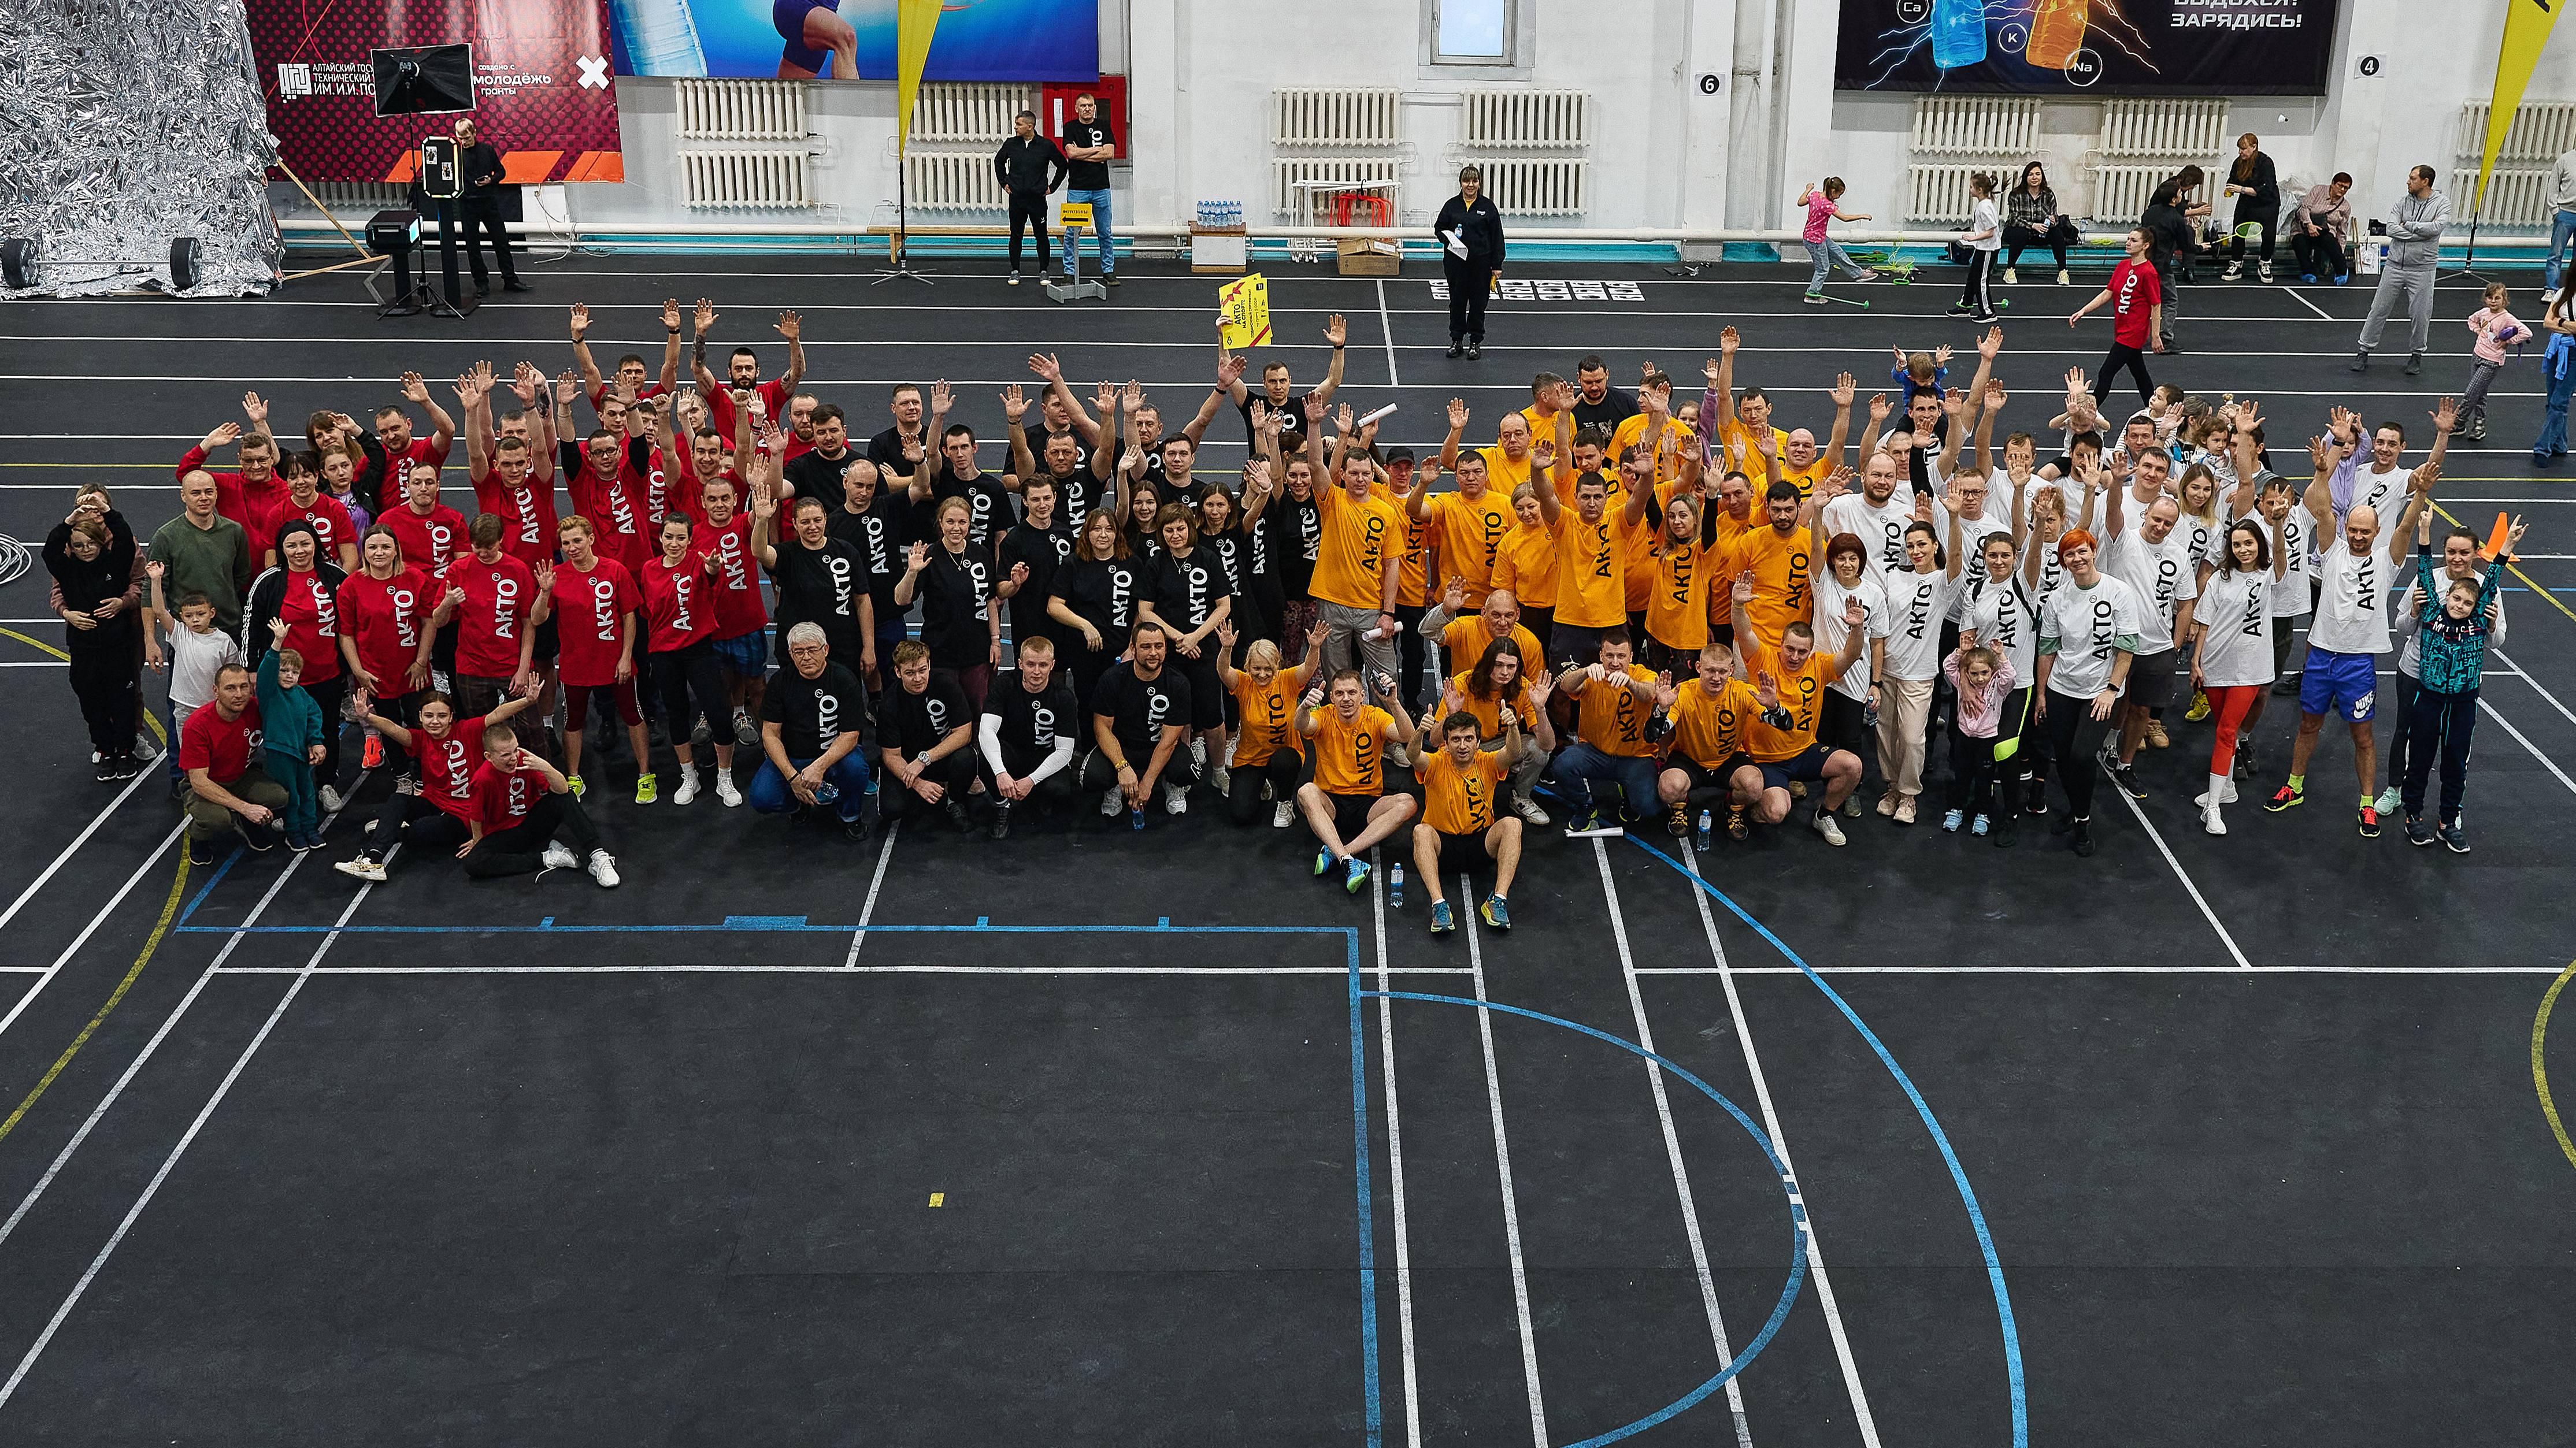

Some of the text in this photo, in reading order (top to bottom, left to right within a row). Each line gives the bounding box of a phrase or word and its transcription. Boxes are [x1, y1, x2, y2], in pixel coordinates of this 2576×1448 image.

[1903, 2, 1921, 12] Ca
[2170, 13, 2302, 31] ЗАРЯДИСЬ!
[2008, 33, 2018, 43] K
[313, 62, 355, 72] АЛТАЙСКИЙ
[313, 72, 371, 83] ТЕХНИЧЕСКИЙ
[481, 87, 516, 97] гранты
[1705, 78, 1715, 92] 6
[2074, 62, 2092, 72] Na
[2364, 60, 2375, 73] 4
[1233, 304, 1241, 325] АКТО
[2118, 274, 2137, 314] АКТО
[650, 470, 665, 523] АКТО
[721, 532, 747, 589] АКТО
[867, 518, 889, 574] АКТО
[831, 558, 850, 615] АКТО
[971, 562, 989, 621] АКТО
[1113, 570, 1132, 626] АКТО
[1189, 567, 1207, 625] АКТО
[1785, 552, 1808, 610] АКТО
[496, 579, 517, 638] АКТО
[595, 580, 614, 640] АКТО
[1906, 583, 1933, 639] АКТО
[1999, 589, 2017, 648] АКТО
[2092, 600, 2111, 661] АКТО
[926, 699, 951, 741] КТО
[1269, 694, 1286, 745] АКТО
[1617, 692, 1639, 742] АКТО
[2355, 690, 2374, 710] NIKE
[1035, 708, 1054, 747] КТО
[448, 740, 470, 798] АКТО
[1355, 732, 1373, 785] АКТО
